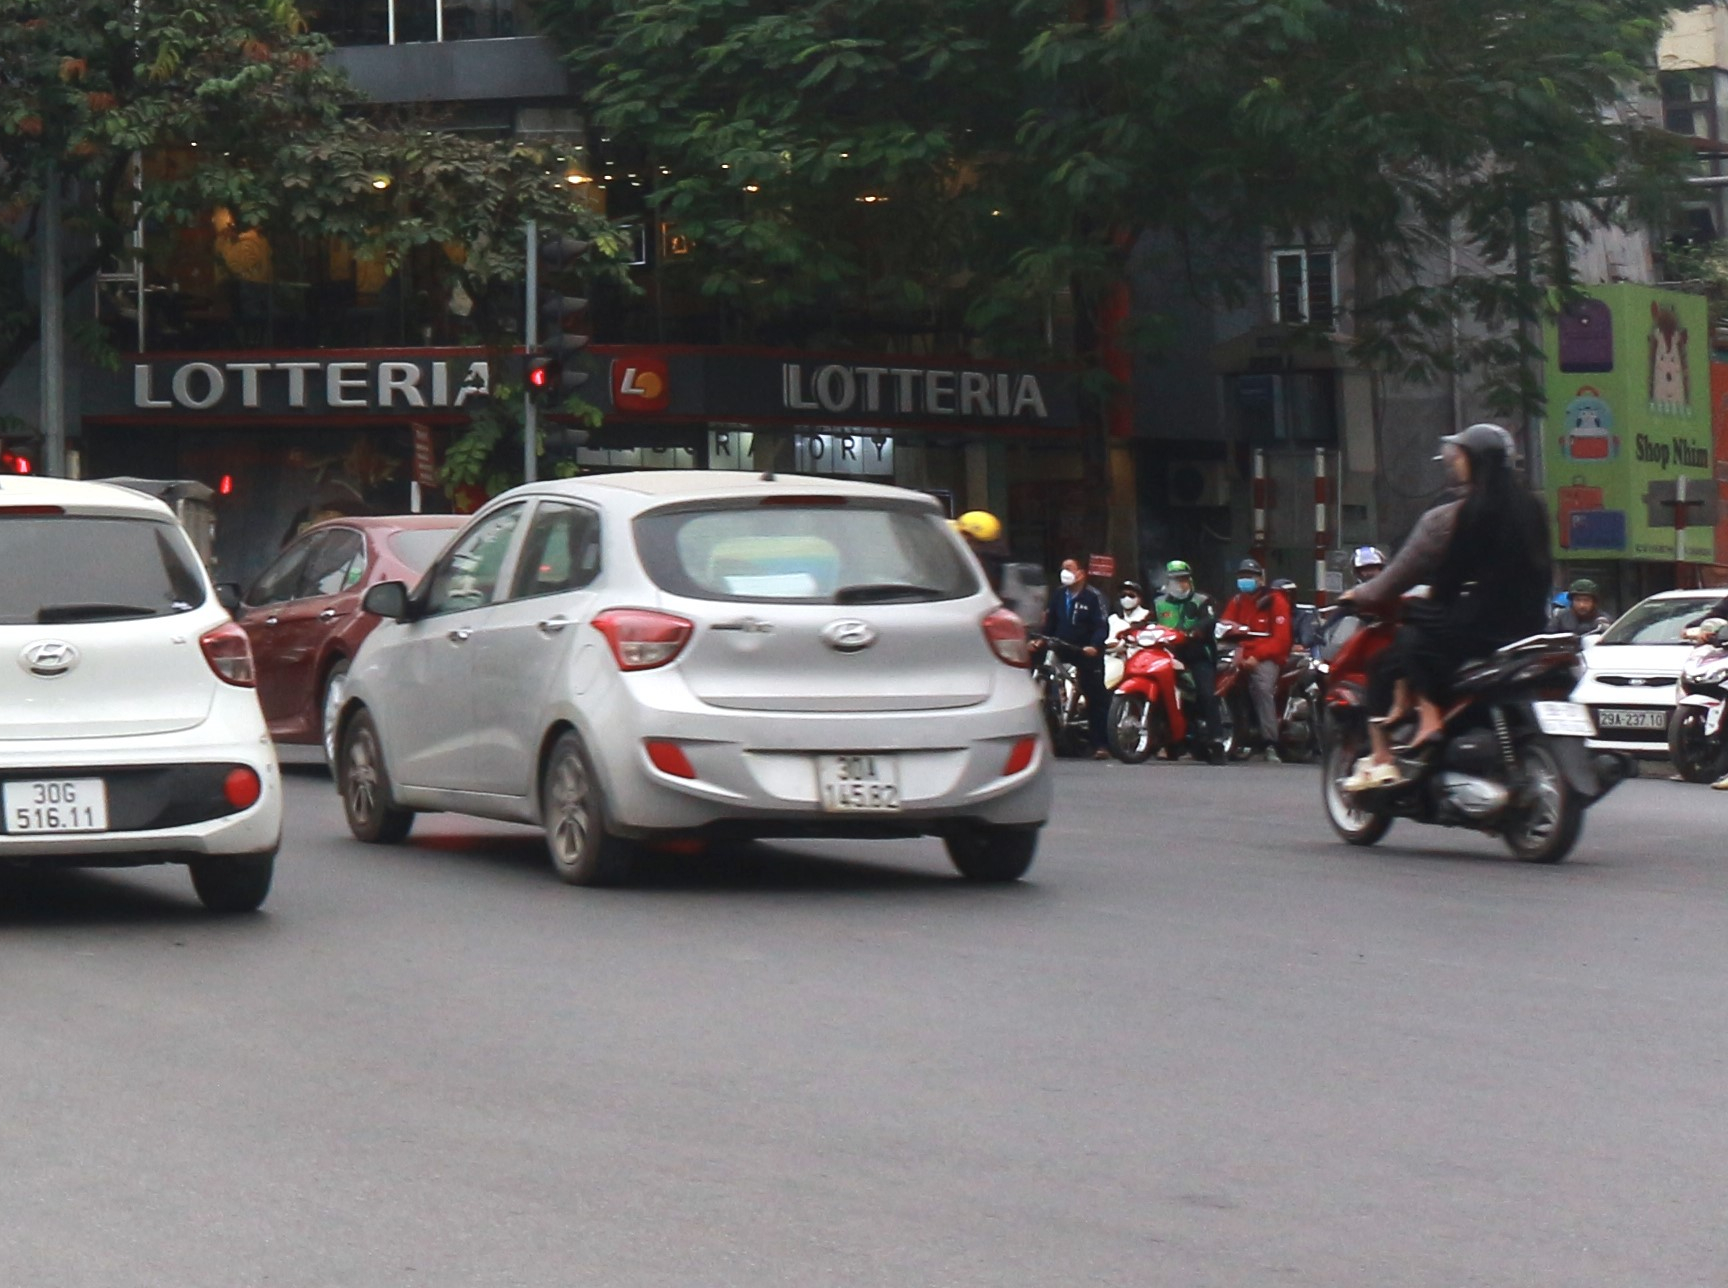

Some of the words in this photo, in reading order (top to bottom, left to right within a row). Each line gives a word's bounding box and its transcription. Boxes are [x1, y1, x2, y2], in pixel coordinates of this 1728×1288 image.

[134, 361, 490, 409] LOTTERIA
[783, 363, 1048, 418] LOTTERIA
[1635, 432, 1670, 470] Shop
[32, 782, 76, 804] 30G
[16, 806, 93, 829] 516.11
